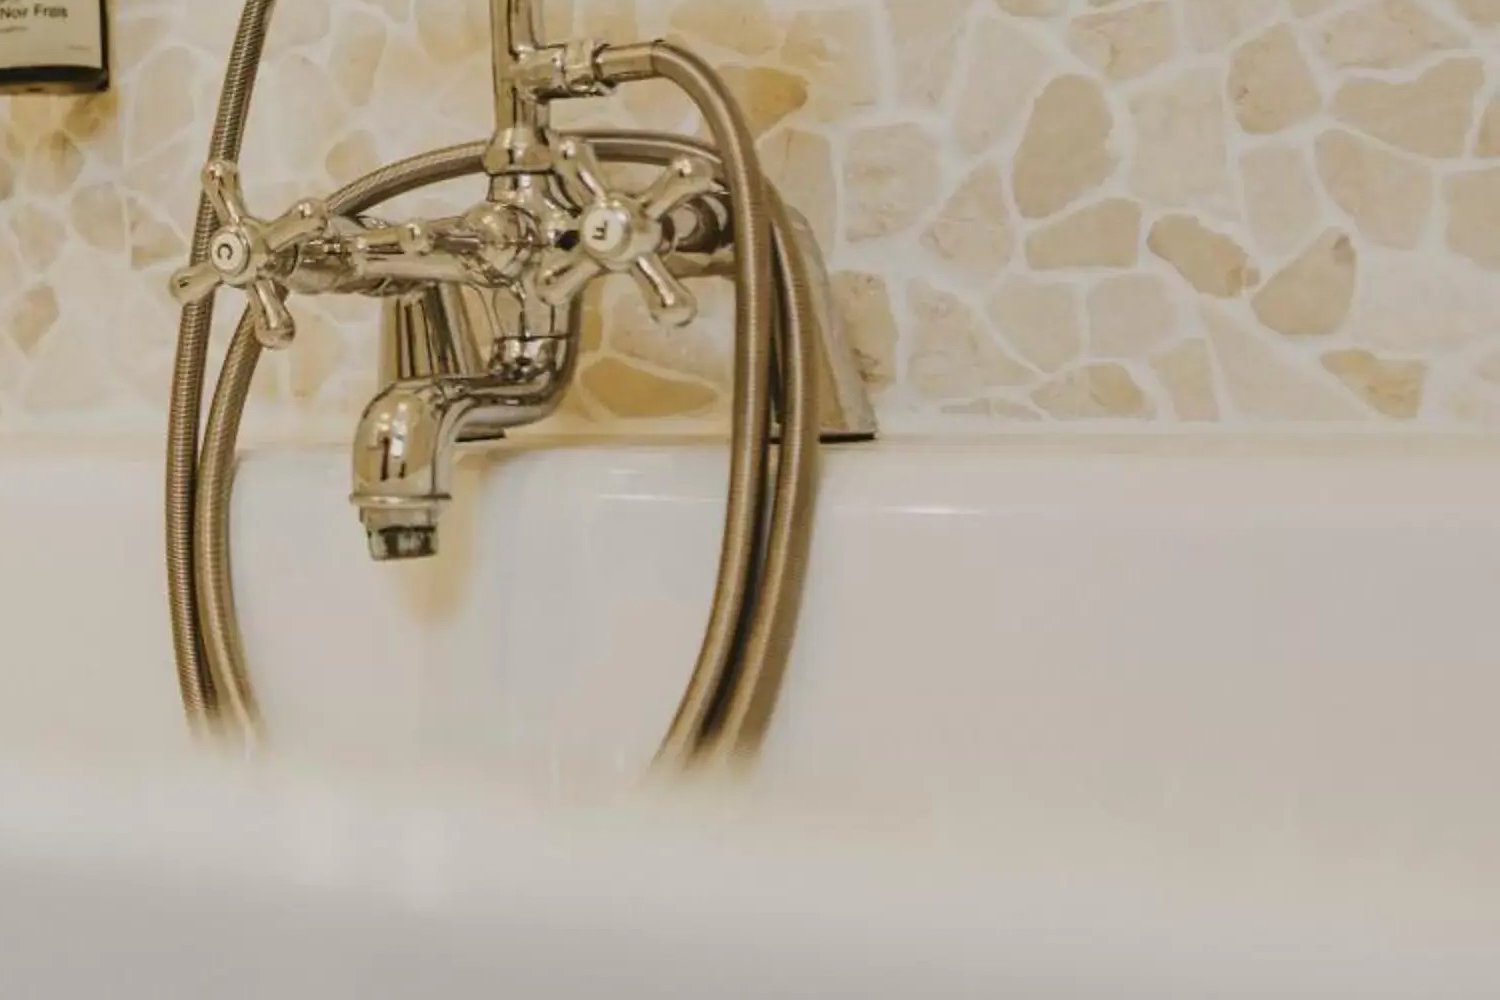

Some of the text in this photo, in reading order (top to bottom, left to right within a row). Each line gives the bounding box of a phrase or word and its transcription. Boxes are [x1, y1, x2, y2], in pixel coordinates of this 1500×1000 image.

[0, 6, 28, 20] Noir
[33, 2, 68, 18] Frais
[217, 243, 233, 260] C
